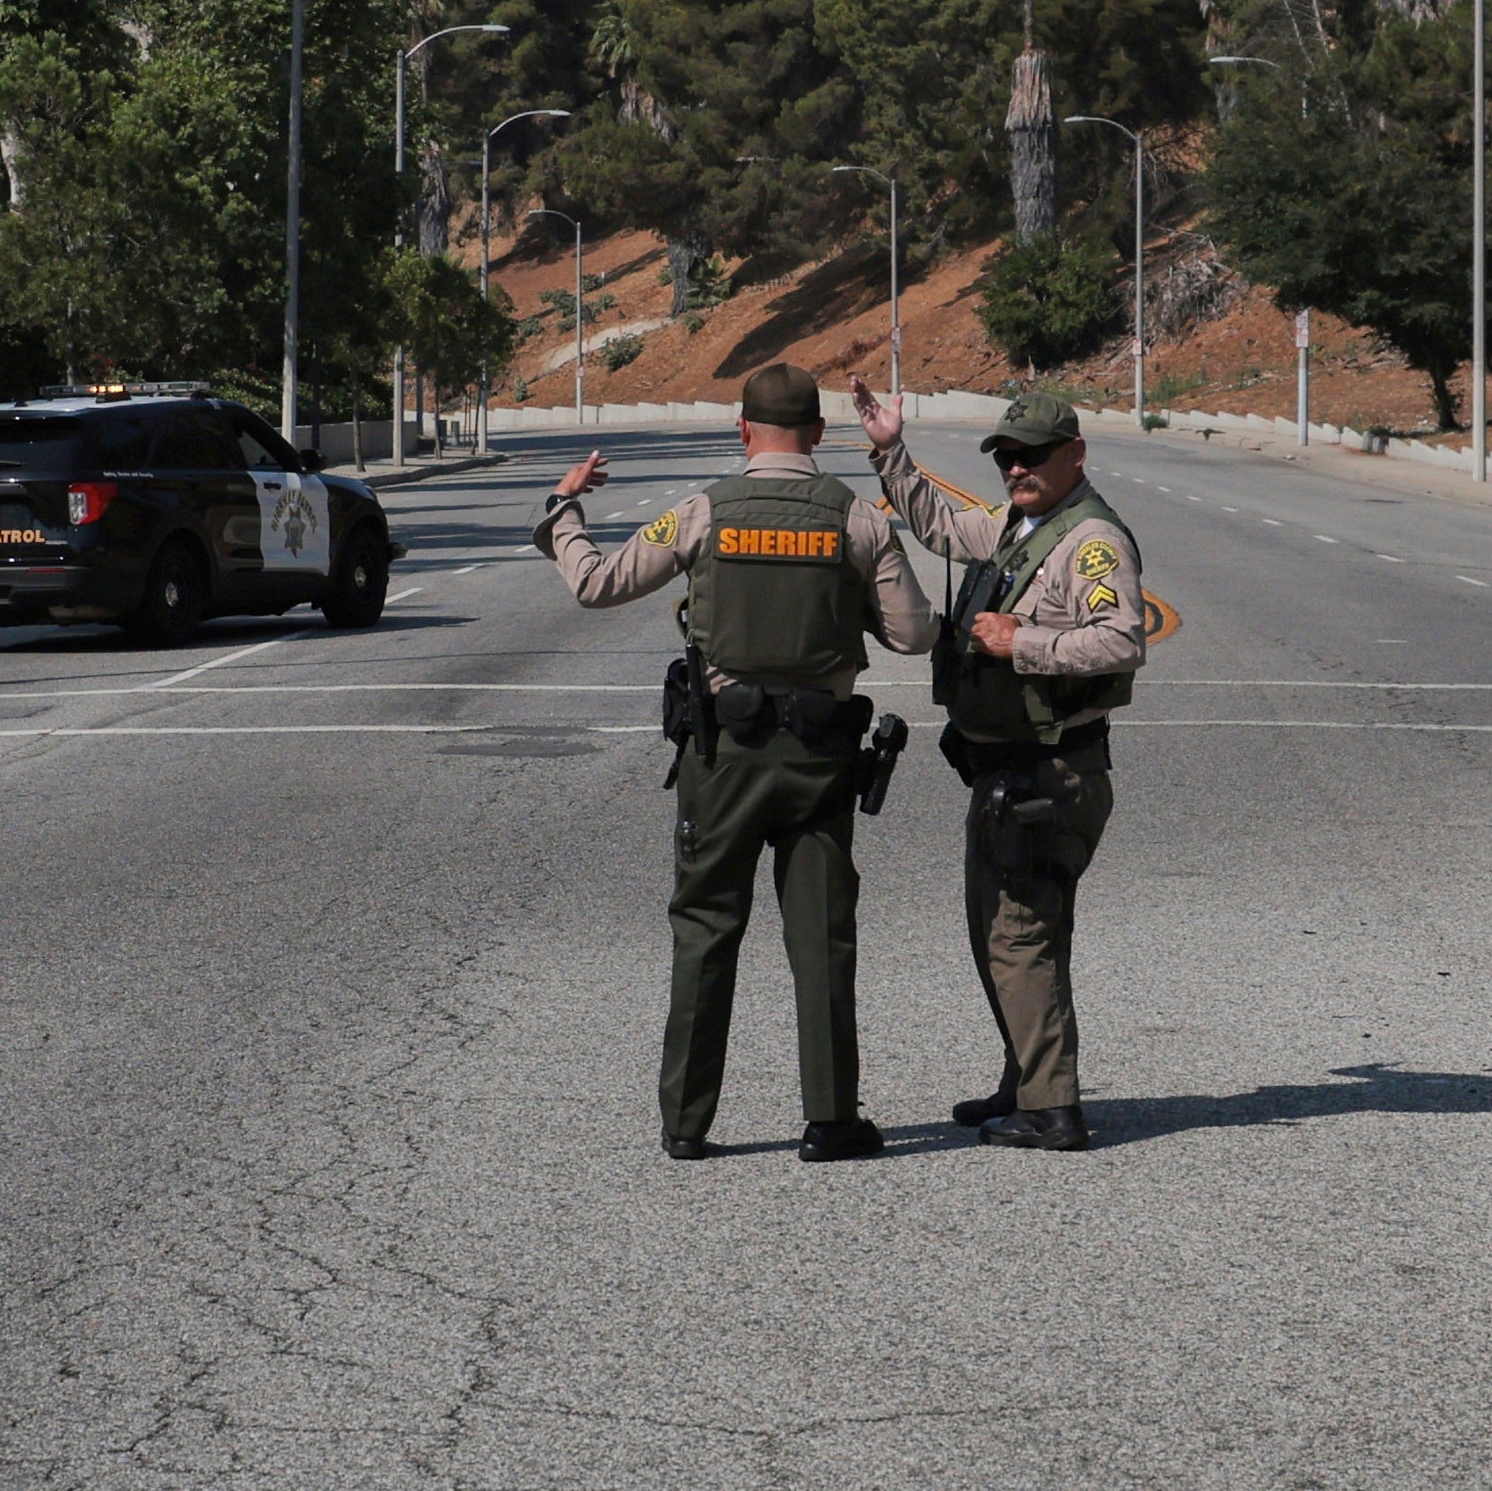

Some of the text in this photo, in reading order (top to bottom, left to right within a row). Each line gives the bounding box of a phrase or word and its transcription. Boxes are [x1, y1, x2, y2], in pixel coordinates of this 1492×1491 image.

[271, 490, 319, 534] HIGHWAY PATROL
[719, 527, 839, 557] SHERIFF
